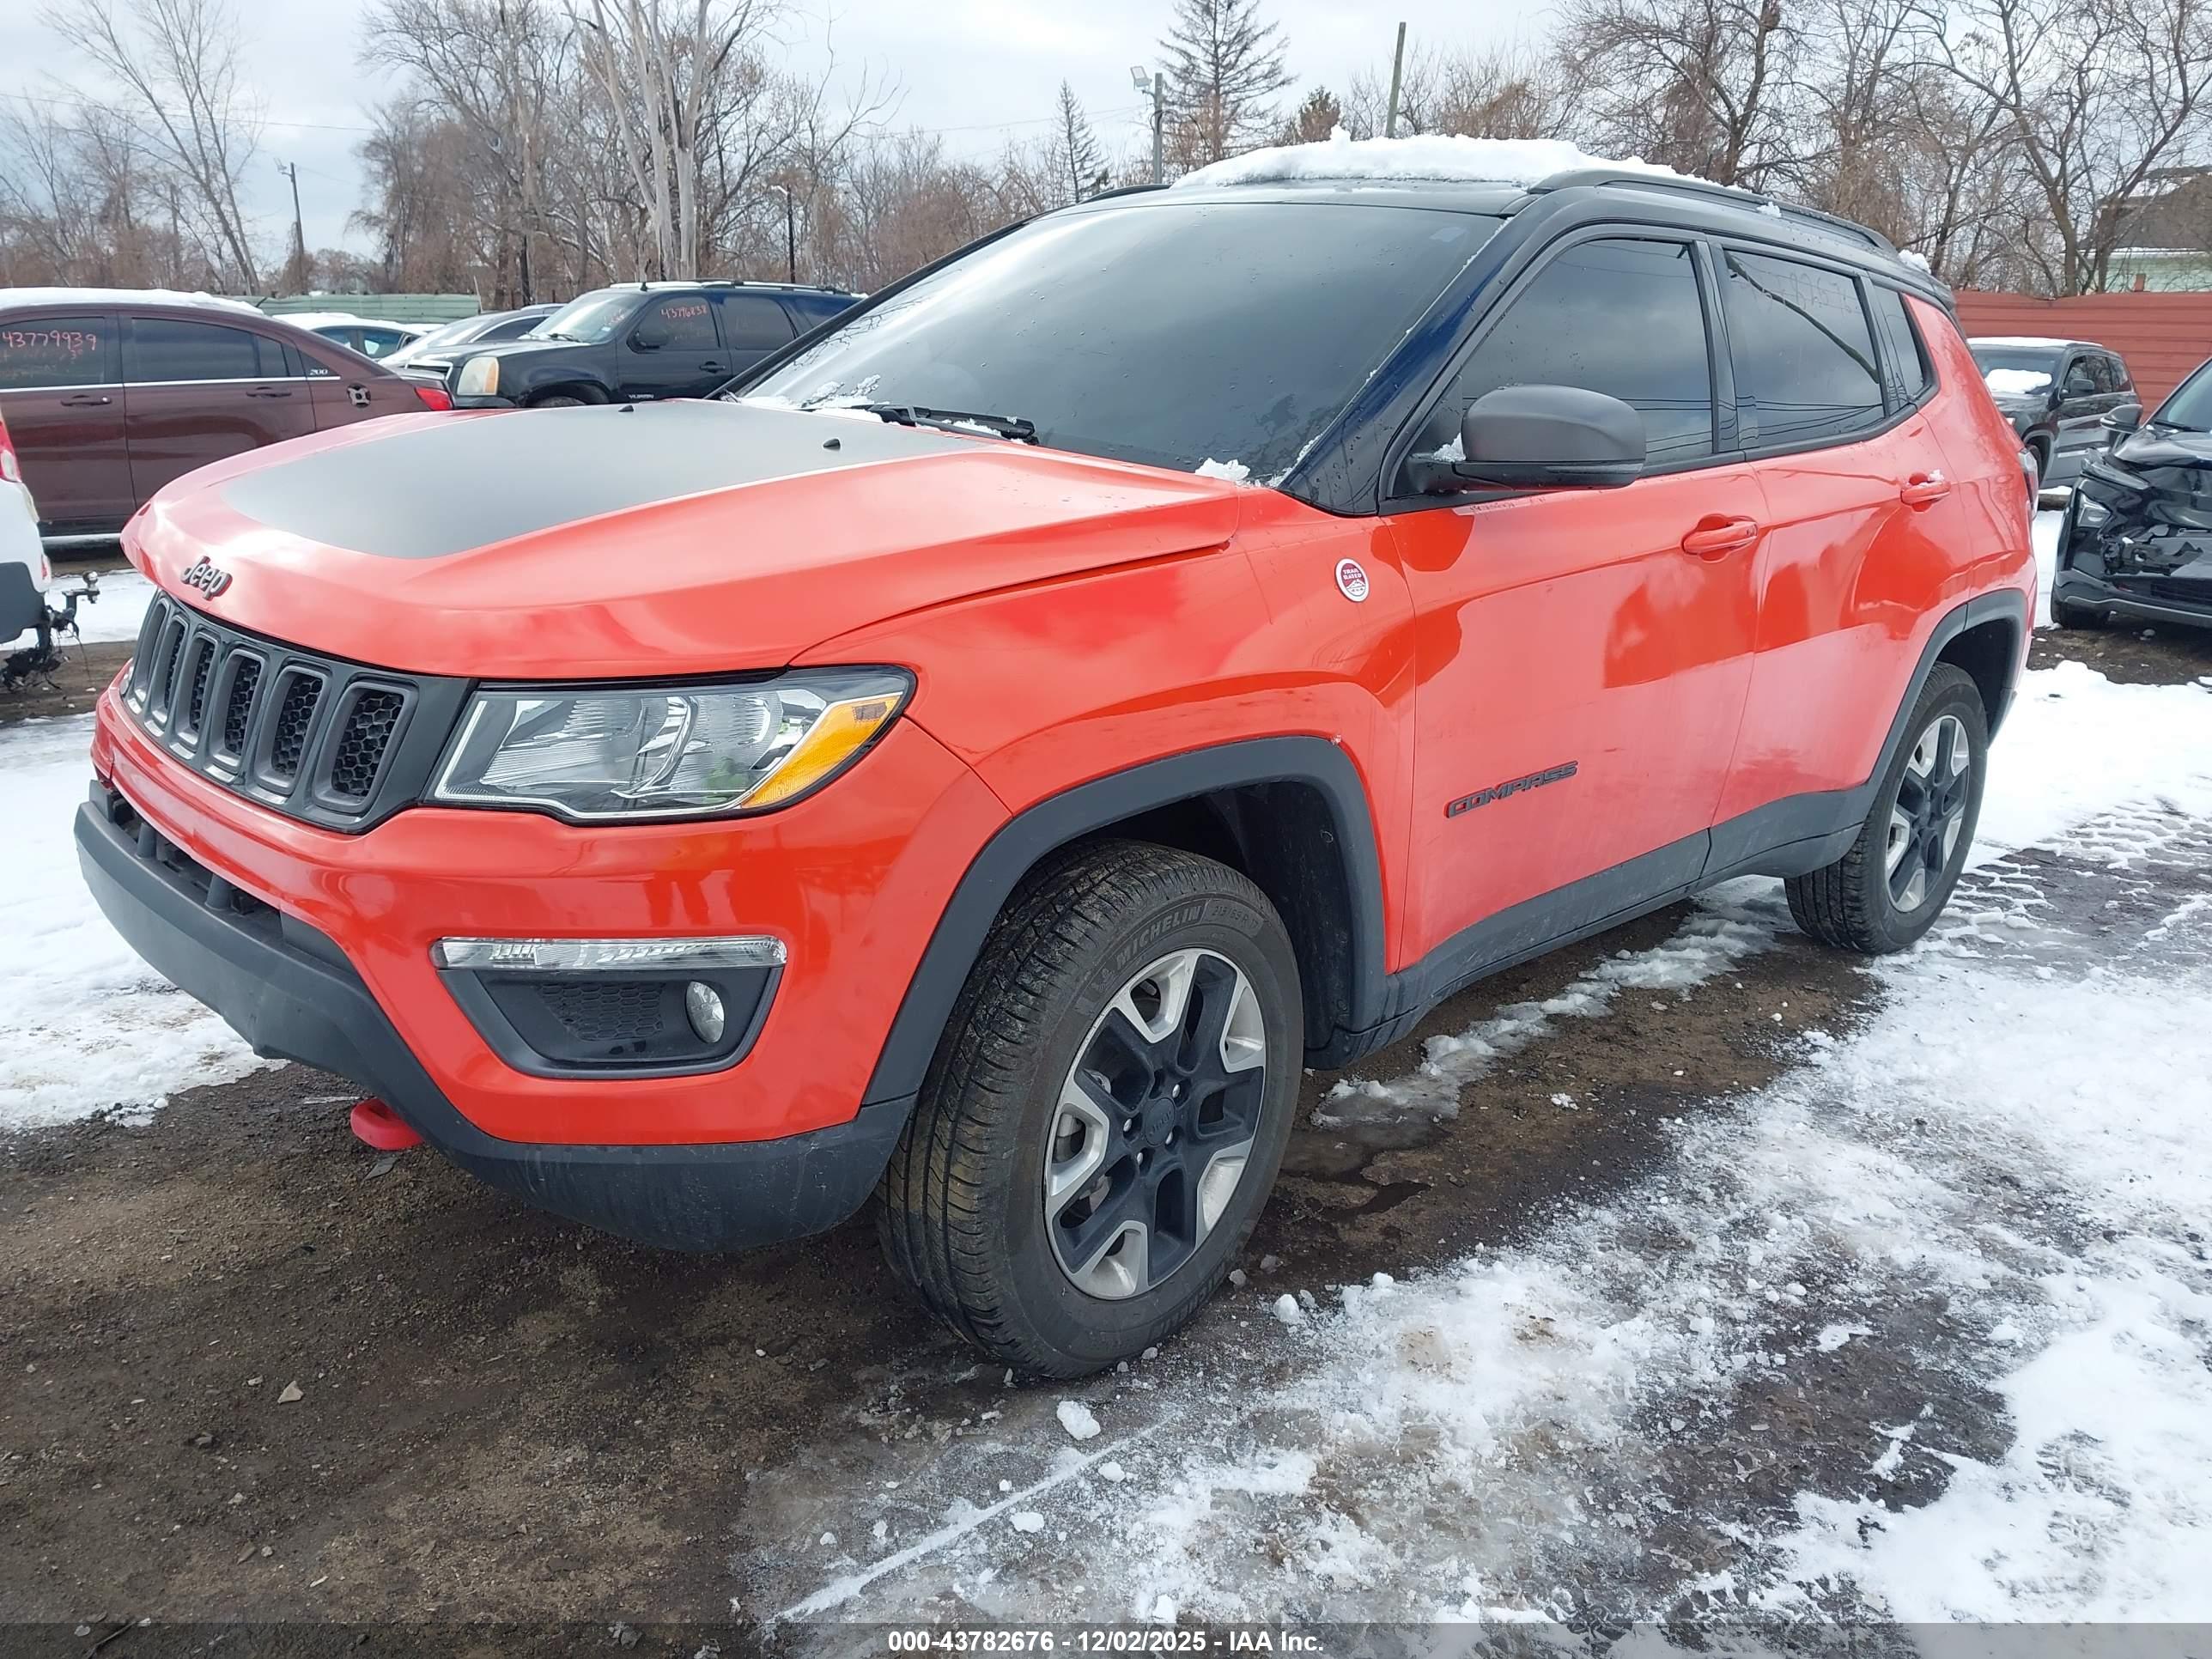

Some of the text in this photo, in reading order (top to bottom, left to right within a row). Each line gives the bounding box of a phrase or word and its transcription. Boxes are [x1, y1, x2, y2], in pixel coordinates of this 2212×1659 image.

[2, 329, 97, 351] 43779939
[180, 555, 233, 601] Jeep
[1444, 760, 1578, 818] COMPASS
[1116, 906, 1203, 969] MICHELIN
